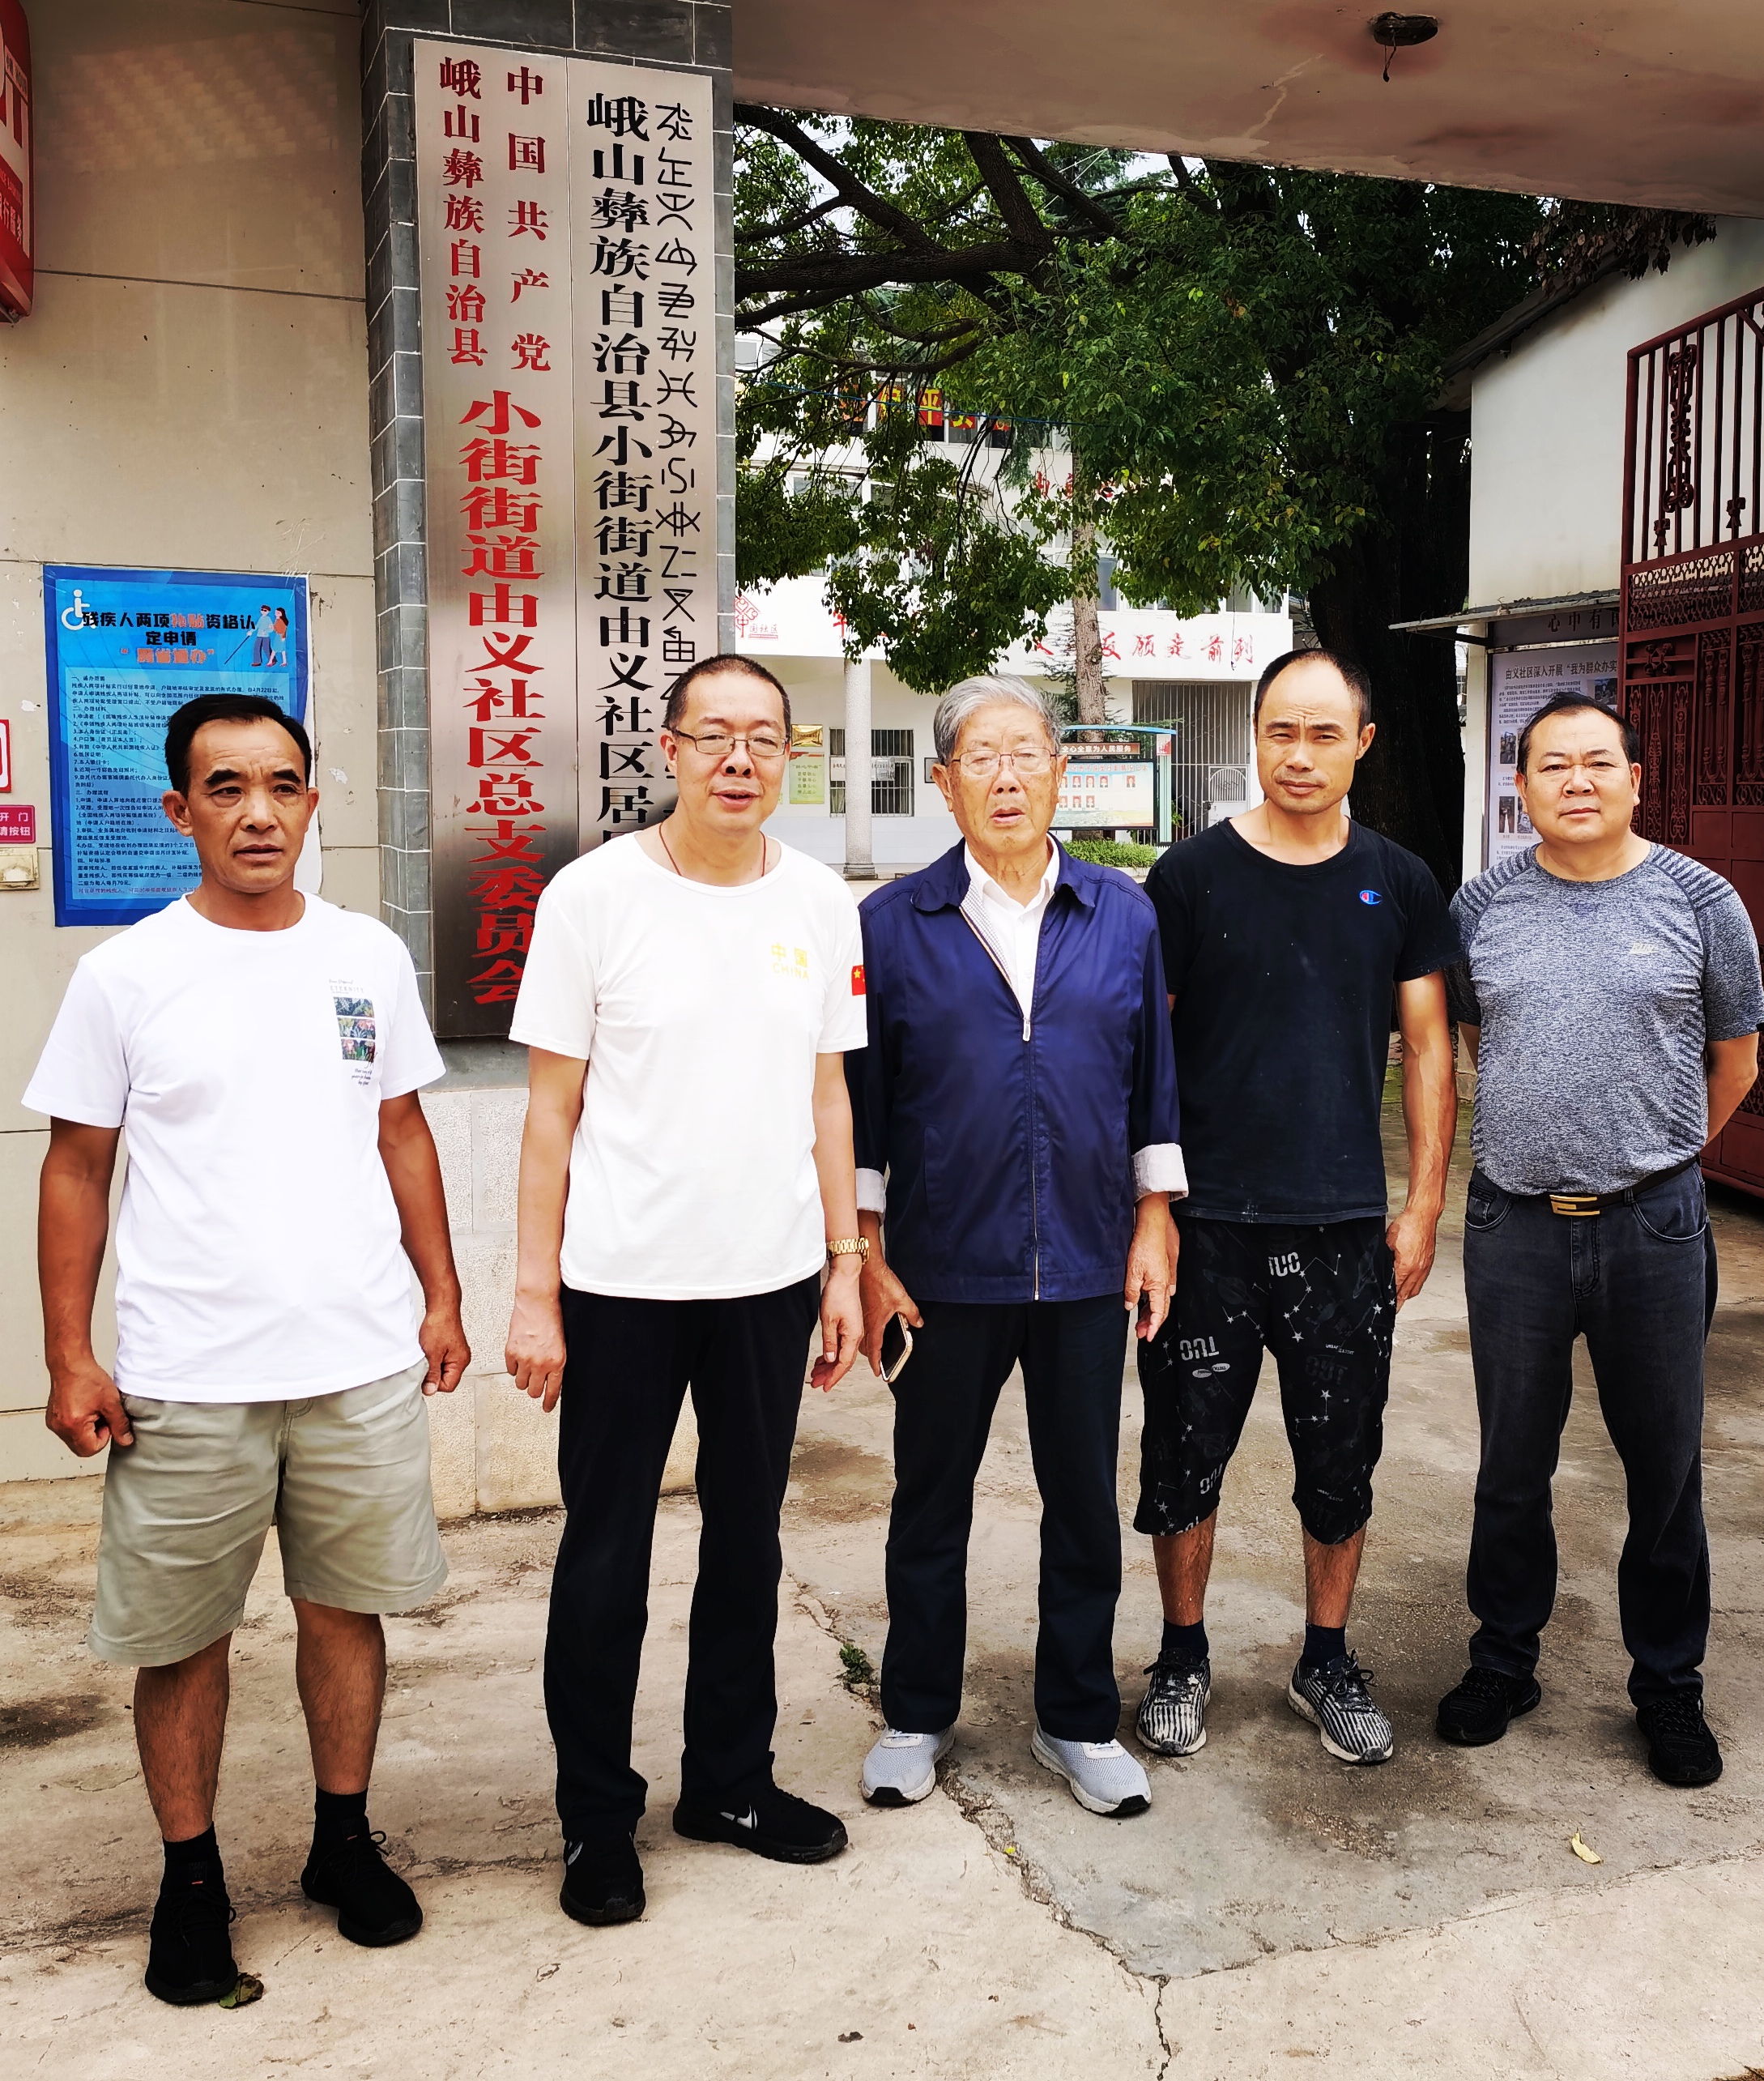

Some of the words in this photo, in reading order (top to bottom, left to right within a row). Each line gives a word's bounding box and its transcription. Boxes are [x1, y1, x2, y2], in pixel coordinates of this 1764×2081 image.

[440, 57, 488, 366] 峨山彝族自治县
[507, 66, 551, 371] 中国共产党
[586, 93, 654, 842] 峨山彝族自治县小街街道由义社区居
[146, 631, 197, 646] 定申请
[1061, 745, 1131, 753] 全心全意为人民服务
